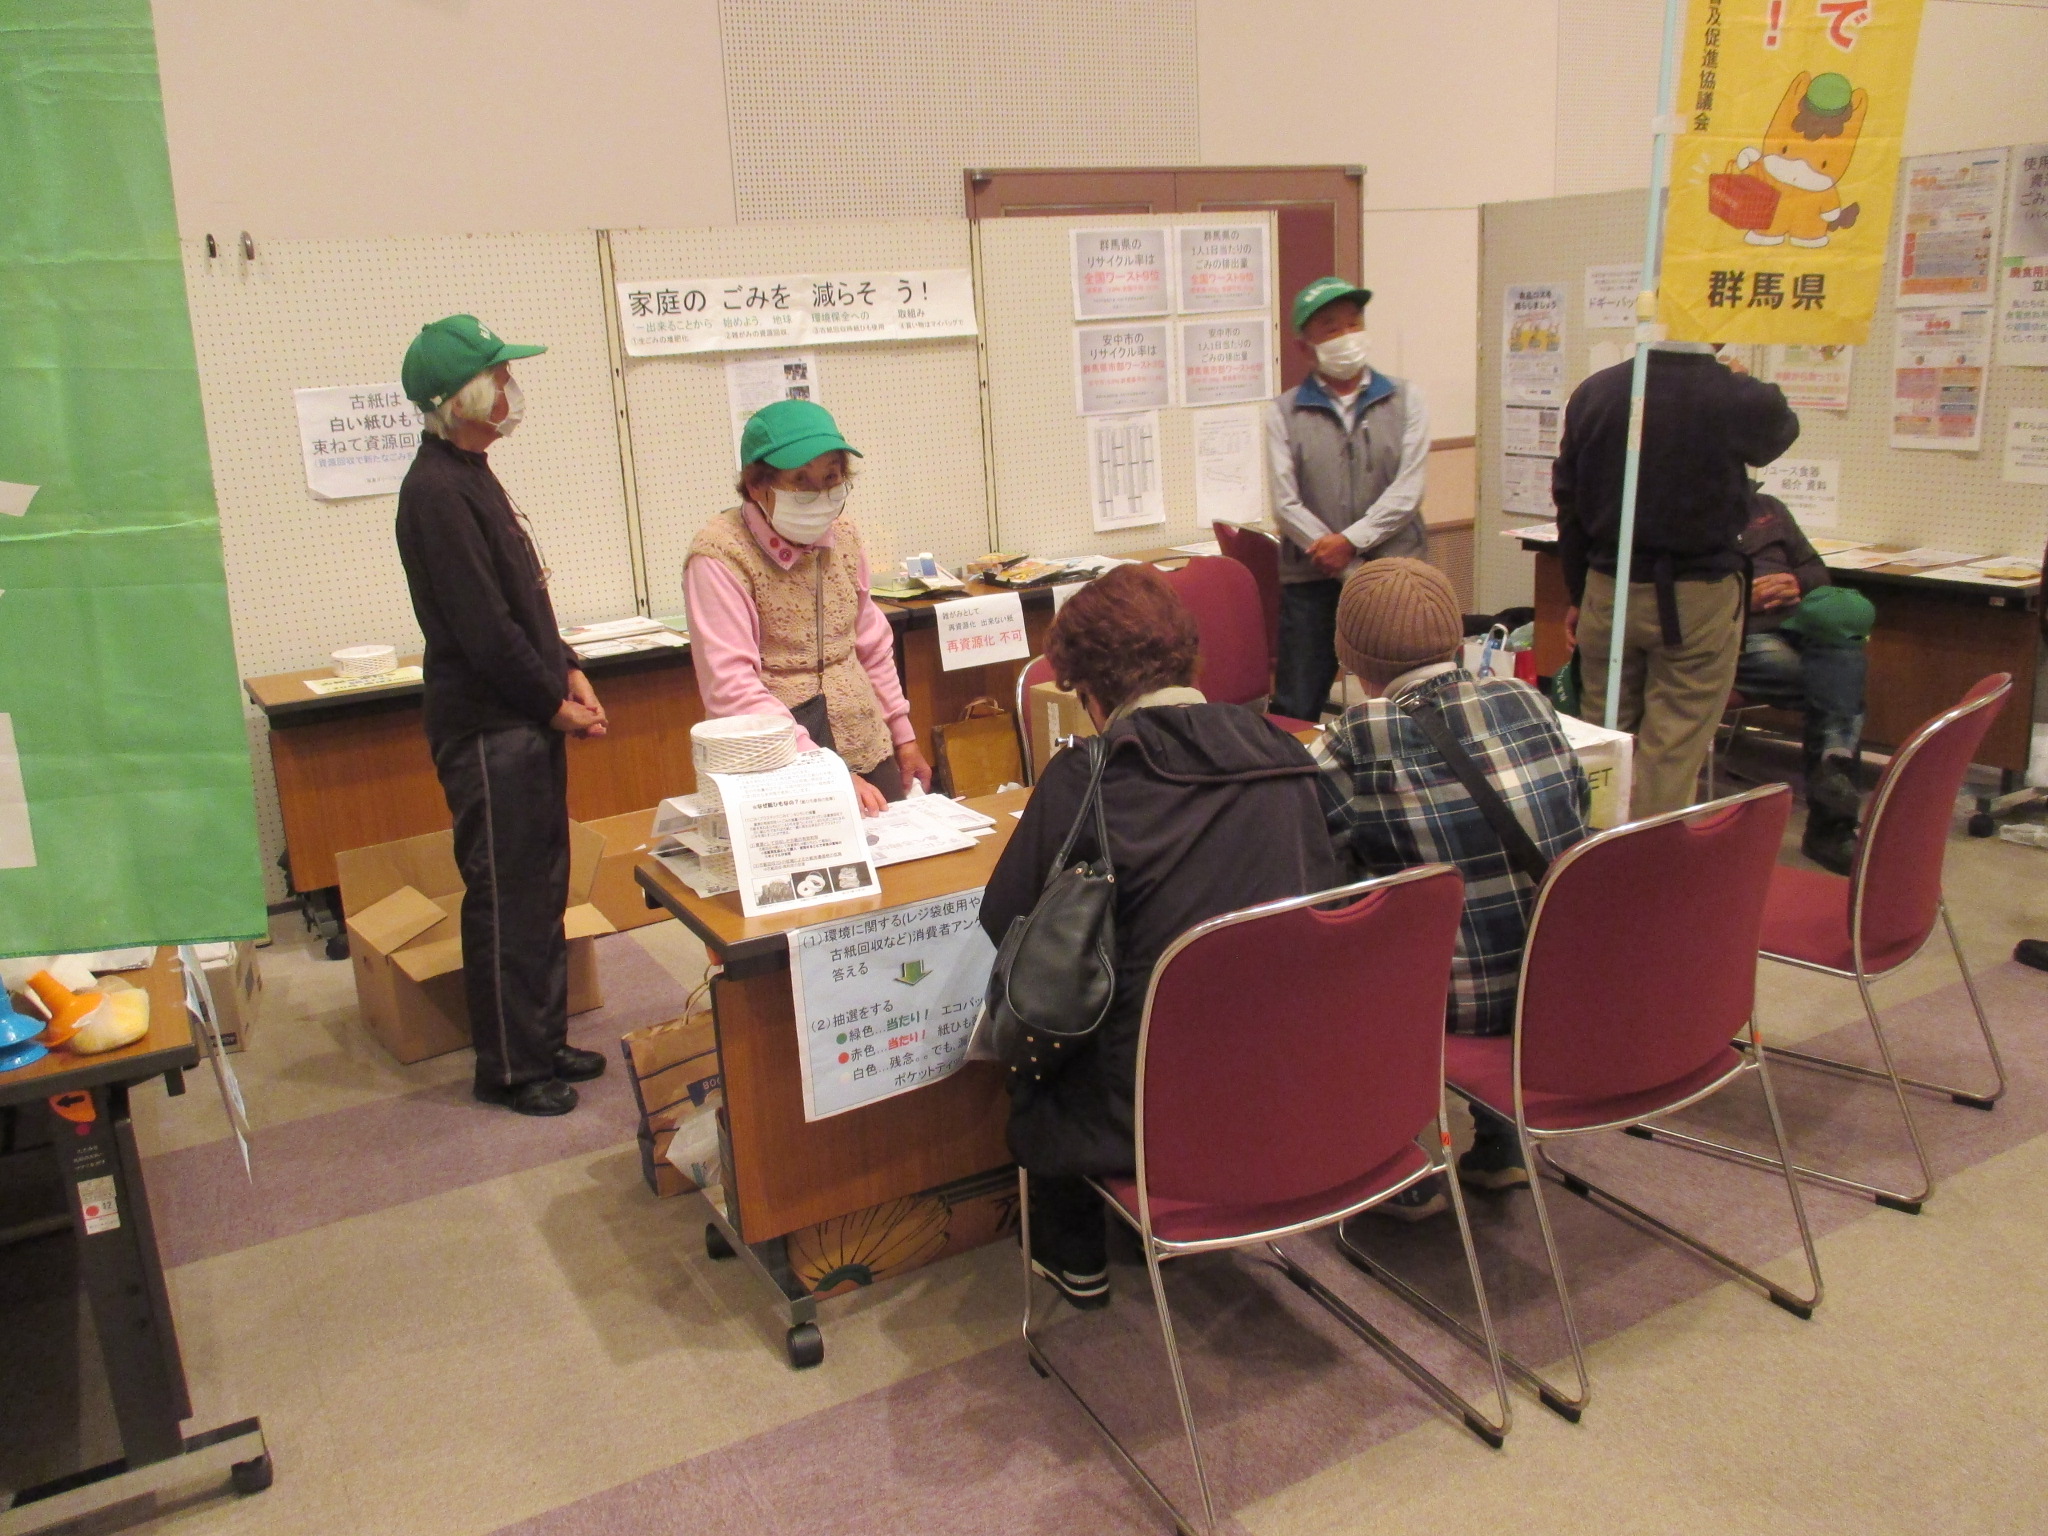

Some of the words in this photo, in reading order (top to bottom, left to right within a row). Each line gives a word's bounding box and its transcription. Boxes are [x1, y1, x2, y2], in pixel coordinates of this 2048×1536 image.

[1820, 0, 1868, 49] で
[1100, 238, 1142, 251] 群馬県の
[1087, 254, 1155, 269] リサイクル率は
[628, 288, 706, 317] 家庭の
[723, 283, 791, 310] ごみを
[812, 280, 876, 307] 減らそ
[897, 279, 928, 304] う！
[1707, 269, 1826, 311] 群馬県
[1589, 297, 1639, 309] ドギーバッ
[811, 311, 870, 322] 環境保全への
[897, 308, 925, 318] 取組み
[1103, 333, 1144, 346] 安中市の
[1090, 346, 1157, 360] リサイクル率は
[349, 391, 402, 410] 古紙は
[948, 621, 976, 631] 再資源化
[946, 634, 996, 653] 再資源化
[1000, 629, 1022, 644] 不可
[832, 962, 869, 983] 答える
[811, 1000, 894, 1033] (2)抽選をする
